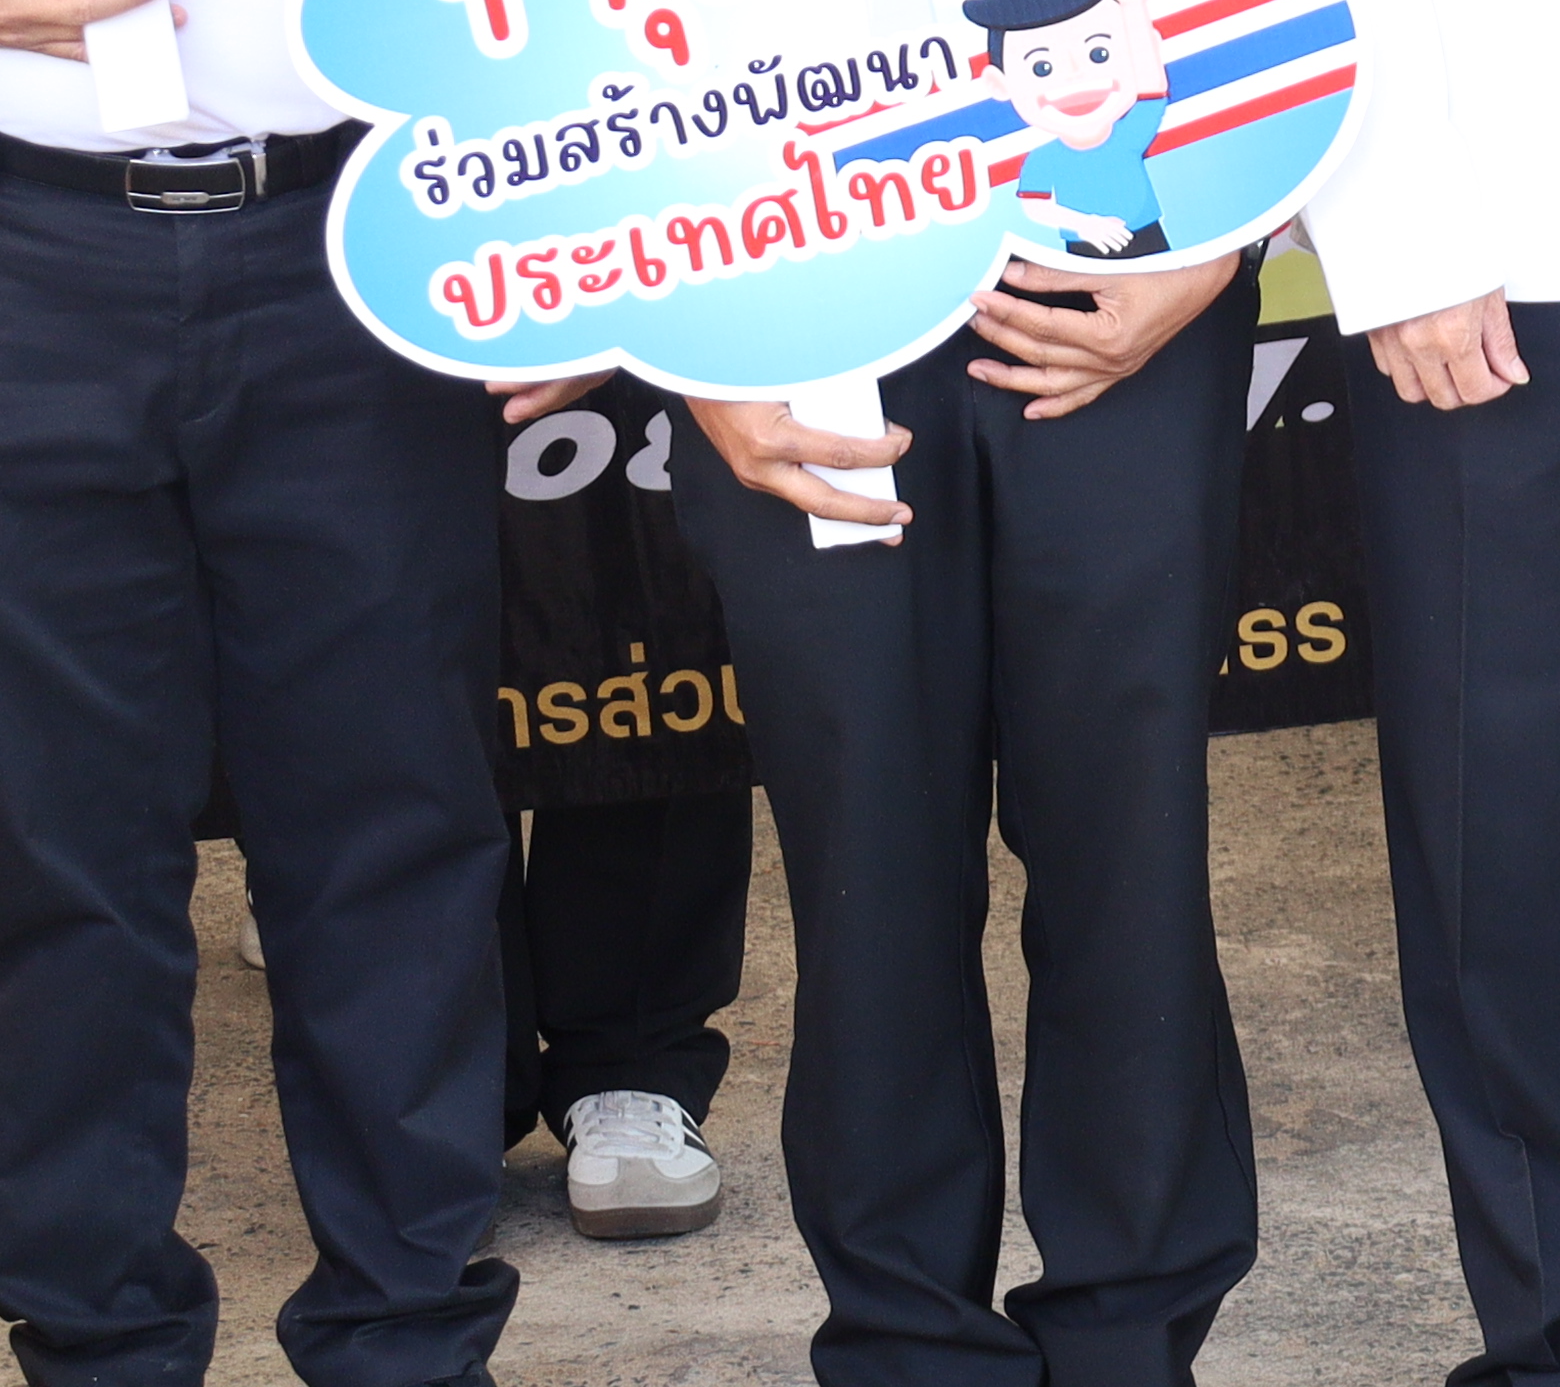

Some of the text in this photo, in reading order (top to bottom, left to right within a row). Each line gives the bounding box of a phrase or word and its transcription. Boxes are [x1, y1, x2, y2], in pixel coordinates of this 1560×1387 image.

[412, 35, 958, 206] ร่วมสร้างพัฒนา
[441, 139, 979, 327] ประเทศไทย
